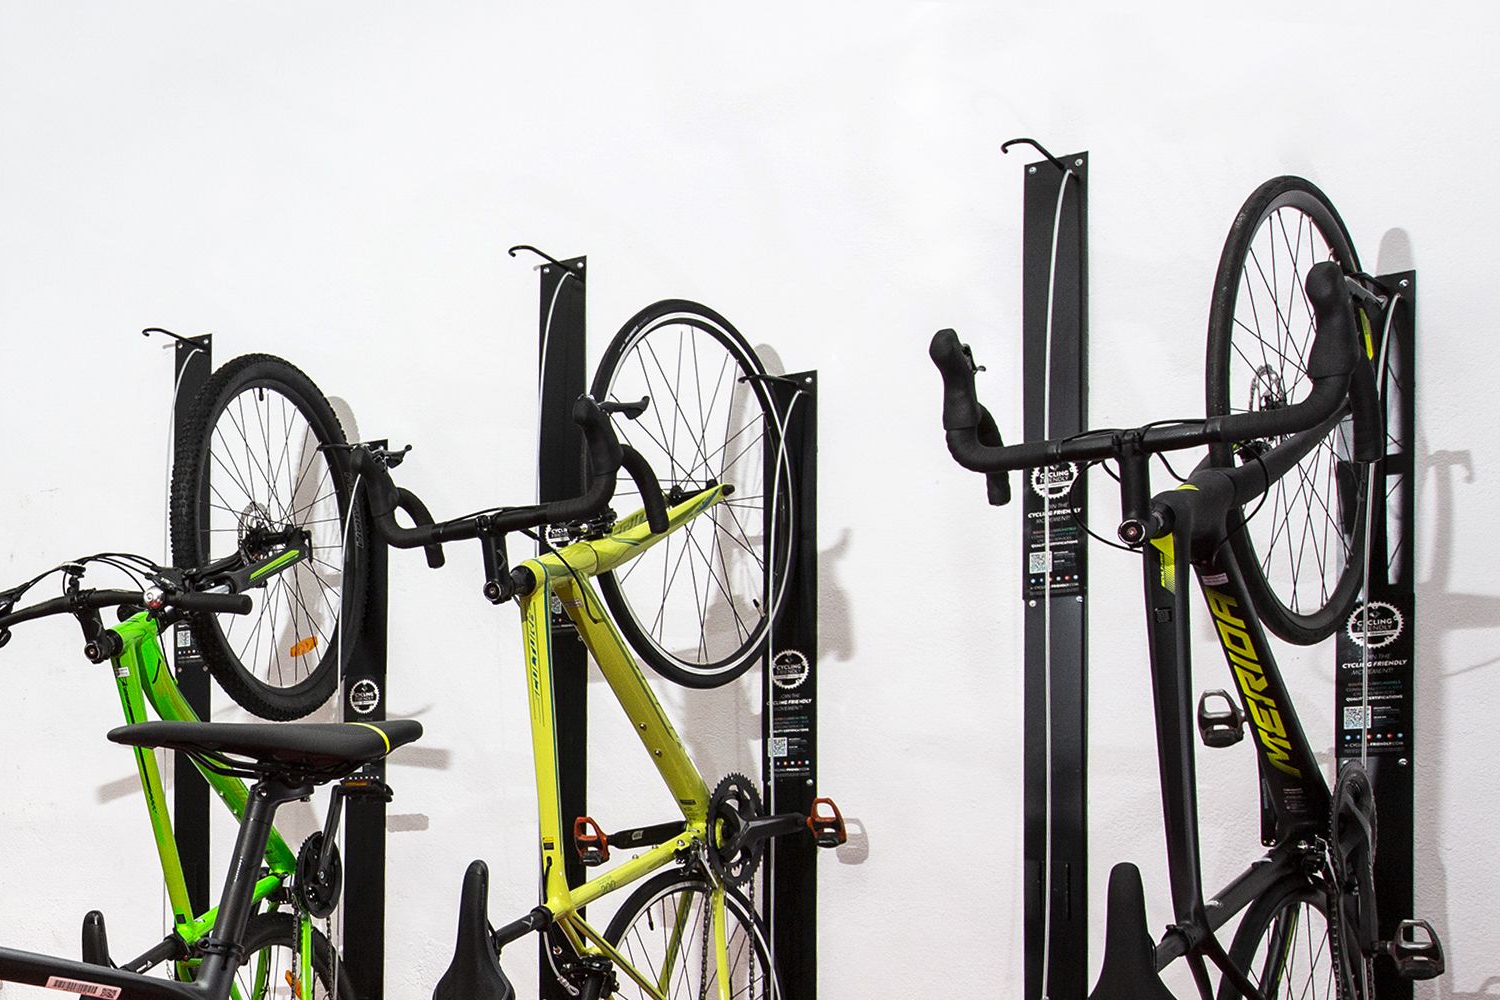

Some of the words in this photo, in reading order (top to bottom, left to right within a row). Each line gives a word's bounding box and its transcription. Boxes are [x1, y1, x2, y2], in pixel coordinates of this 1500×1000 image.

[1040, 469, 1069, 479] CCLING
[1040, 476, 1069, 484] FIENDLY
[1027, 510, 1052, 519] CYCLG
[1053, 507, 1081, 516] FRIENLY
[1356, 617, 1393, 627] CCLING
[1356, 624, 1393, 633] FENDLY
[1342, 660, 1372, 669] CYCLIG
[1205, 587, 1302, 779] MERIDA
